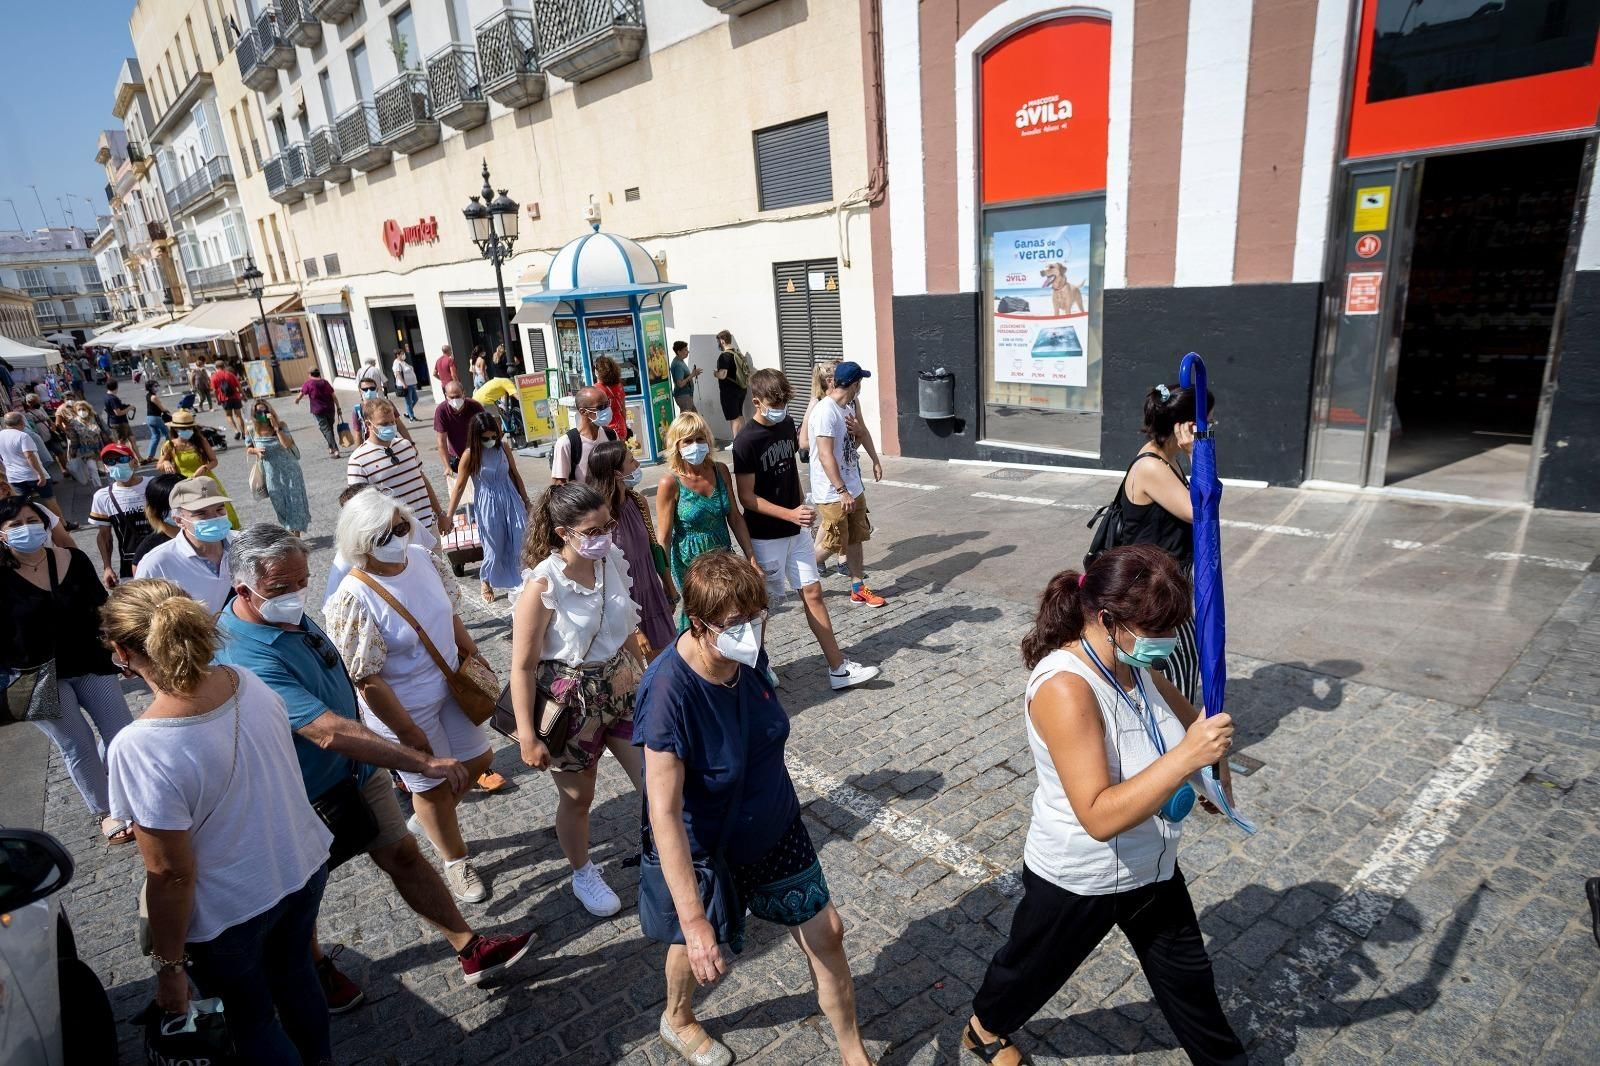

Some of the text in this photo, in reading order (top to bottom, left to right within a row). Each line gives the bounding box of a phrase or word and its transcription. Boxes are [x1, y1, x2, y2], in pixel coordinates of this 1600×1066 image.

[402, 215, 438, 244] market
[1014, 239, 1045, 249] Ganas
[1019, 248, 1064, 260] verano
